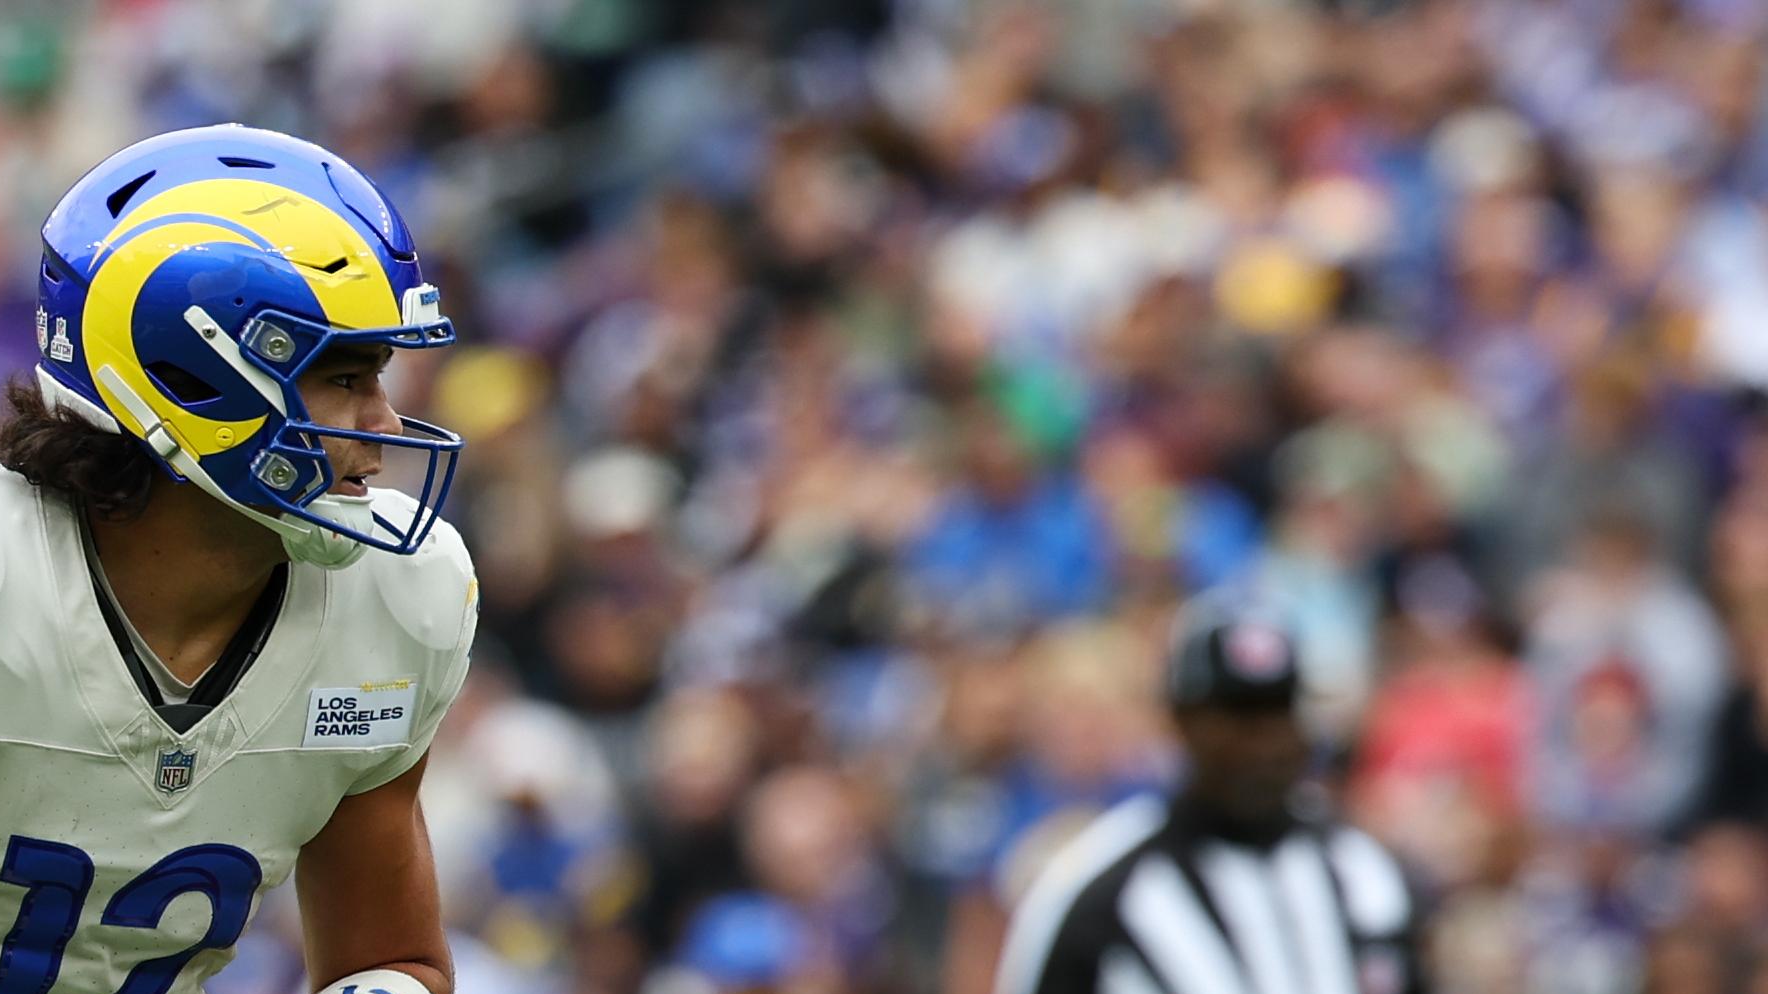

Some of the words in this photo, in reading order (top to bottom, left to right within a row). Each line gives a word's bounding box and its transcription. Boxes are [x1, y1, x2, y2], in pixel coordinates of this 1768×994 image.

[317, 697, 358, 710] LOS
[315, 707, 404, 723] ANGELES
[314, 723, 371, 736] RAMS
[161, 768, 187, 787] NFL
